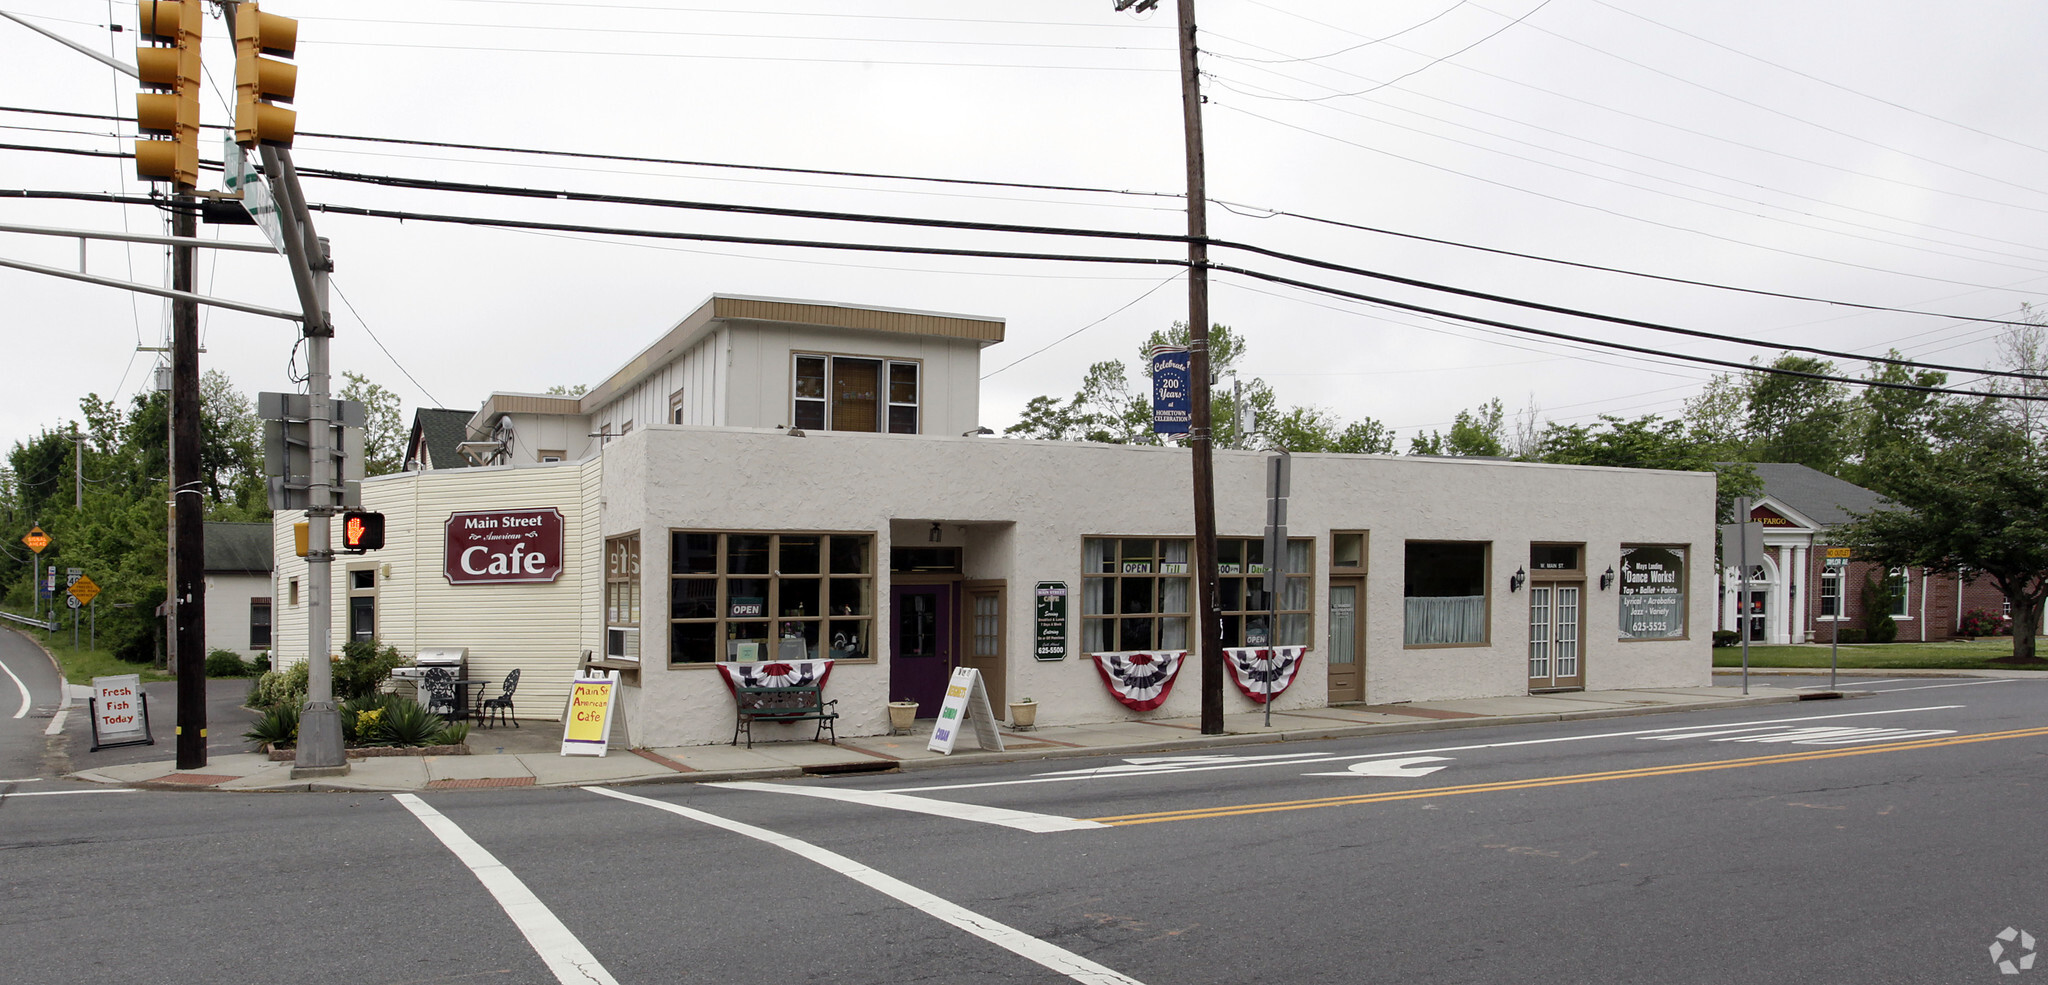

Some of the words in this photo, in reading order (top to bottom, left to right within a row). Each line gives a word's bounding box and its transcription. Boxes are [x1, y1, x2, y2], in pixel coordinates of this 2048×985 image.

[1154, 360, 1186, 372] Celebrate
[1163, 379, 1178, 388] 200
[1159, 388, 1181, 400] Years
[465, 517, 498, 529] Main
[502, 515, 542, 528] Street
[483, 531, 521, 541] American
[460, 543, 545, 575] Cafe
[1125, 564, 1148, 573] OPEN
[1166, 564, 1180, 573] Till
[1627, 571, 1648, 583] Dance
[1651, 571, 1675, 583] Works!
[1623, 587, 1634, 595] Tap
[1639, 586, 1656, 594] Ballet
[1660, 586, 1678, 594] Pointe
[1624, 597, 1642, 607] Lyrical
[1647, 597, 1676, 605] Acrobatics
[733, 605, 760, 614] OPEN
[1630, 608, 1644, 616] Jazz
[1649, 608, 1669, 616] Variety
[1632, 622, 1666, 631] 625-5525
[102, 687, 132, 697] Fresh
[575, 686, 599, 695] Main
[107, 701, 129, 710] Fish
[573, 697, 608, 707] American
[102, 715, 134, 725] Today
[577, 711, 601, 721] Cafe
